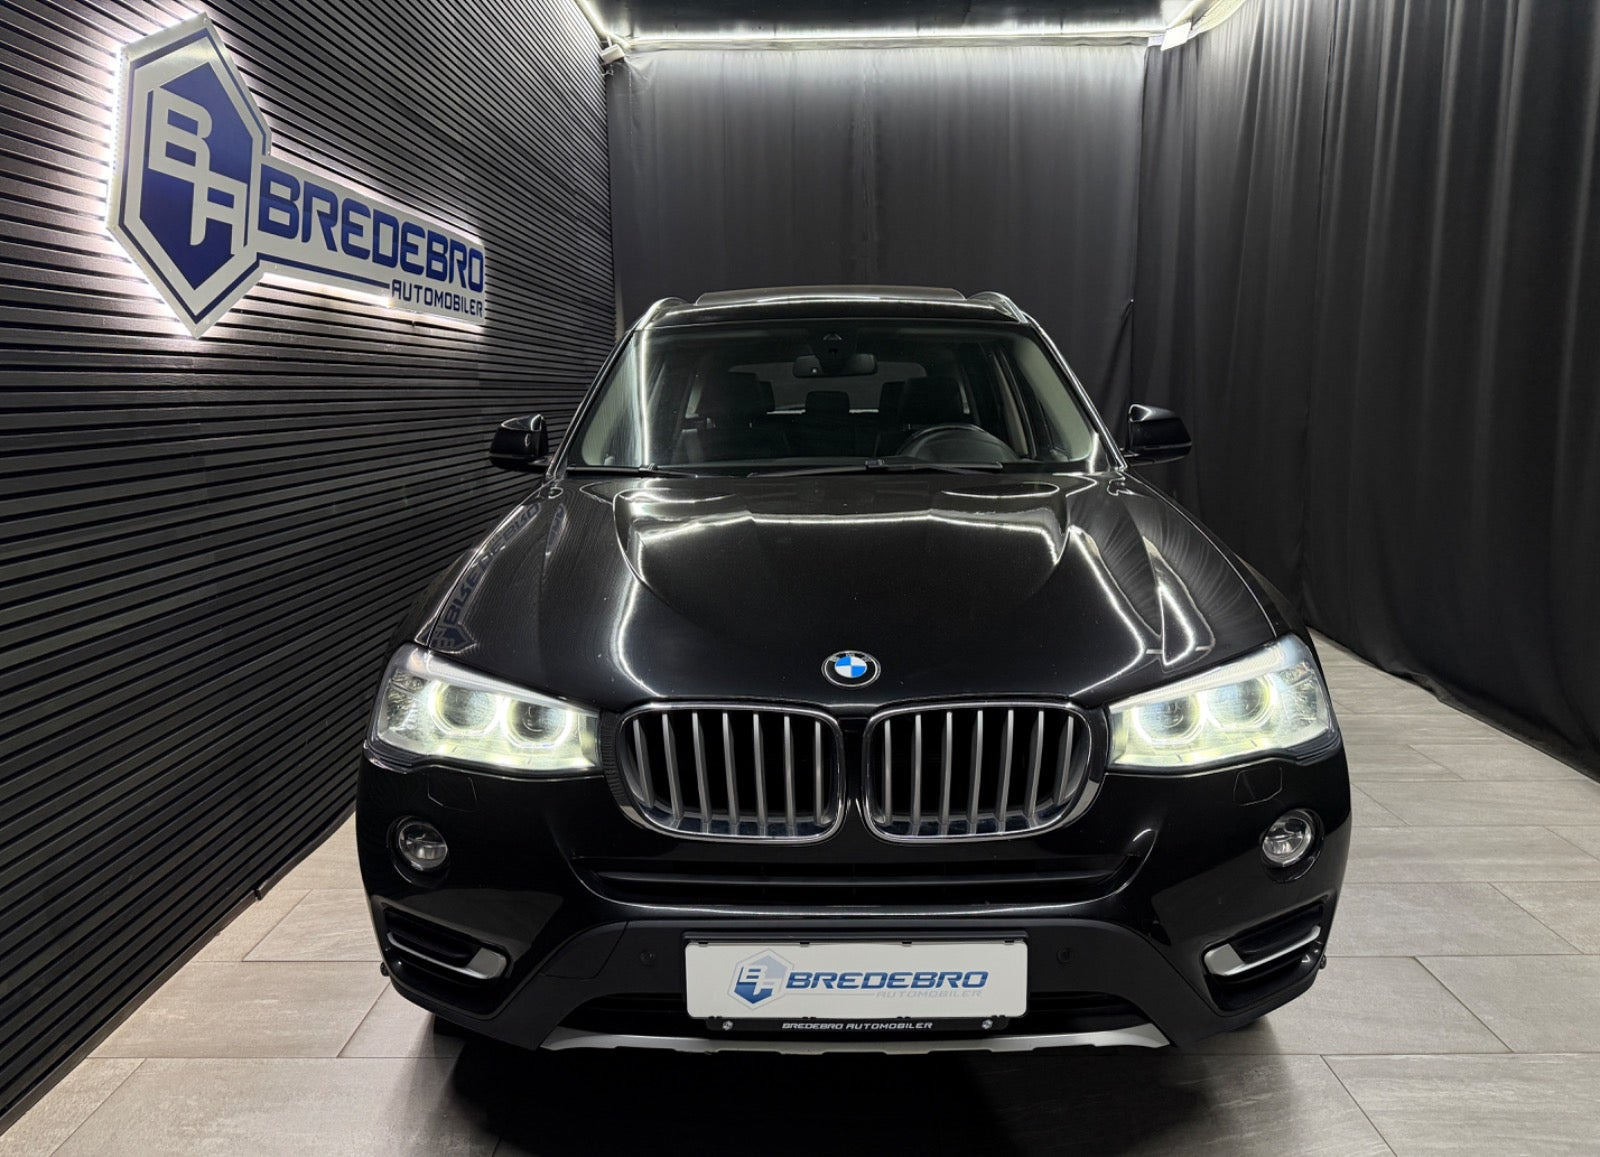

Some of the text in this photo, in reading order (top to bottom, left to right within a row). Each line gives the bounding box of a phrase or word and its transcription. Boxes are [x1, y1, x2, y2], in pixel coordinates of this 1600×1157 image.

[257, 163, 484, 293] BREDEBRO
[391, 279, 483, 318] AUTOMOBILER
[786, 971, 989, 989] BREDEBRO
[876, 990, 982, 999] AUTOMOBILER
[782, 1022, 933, 1030] BREDEBRO AUTOMOBILER
